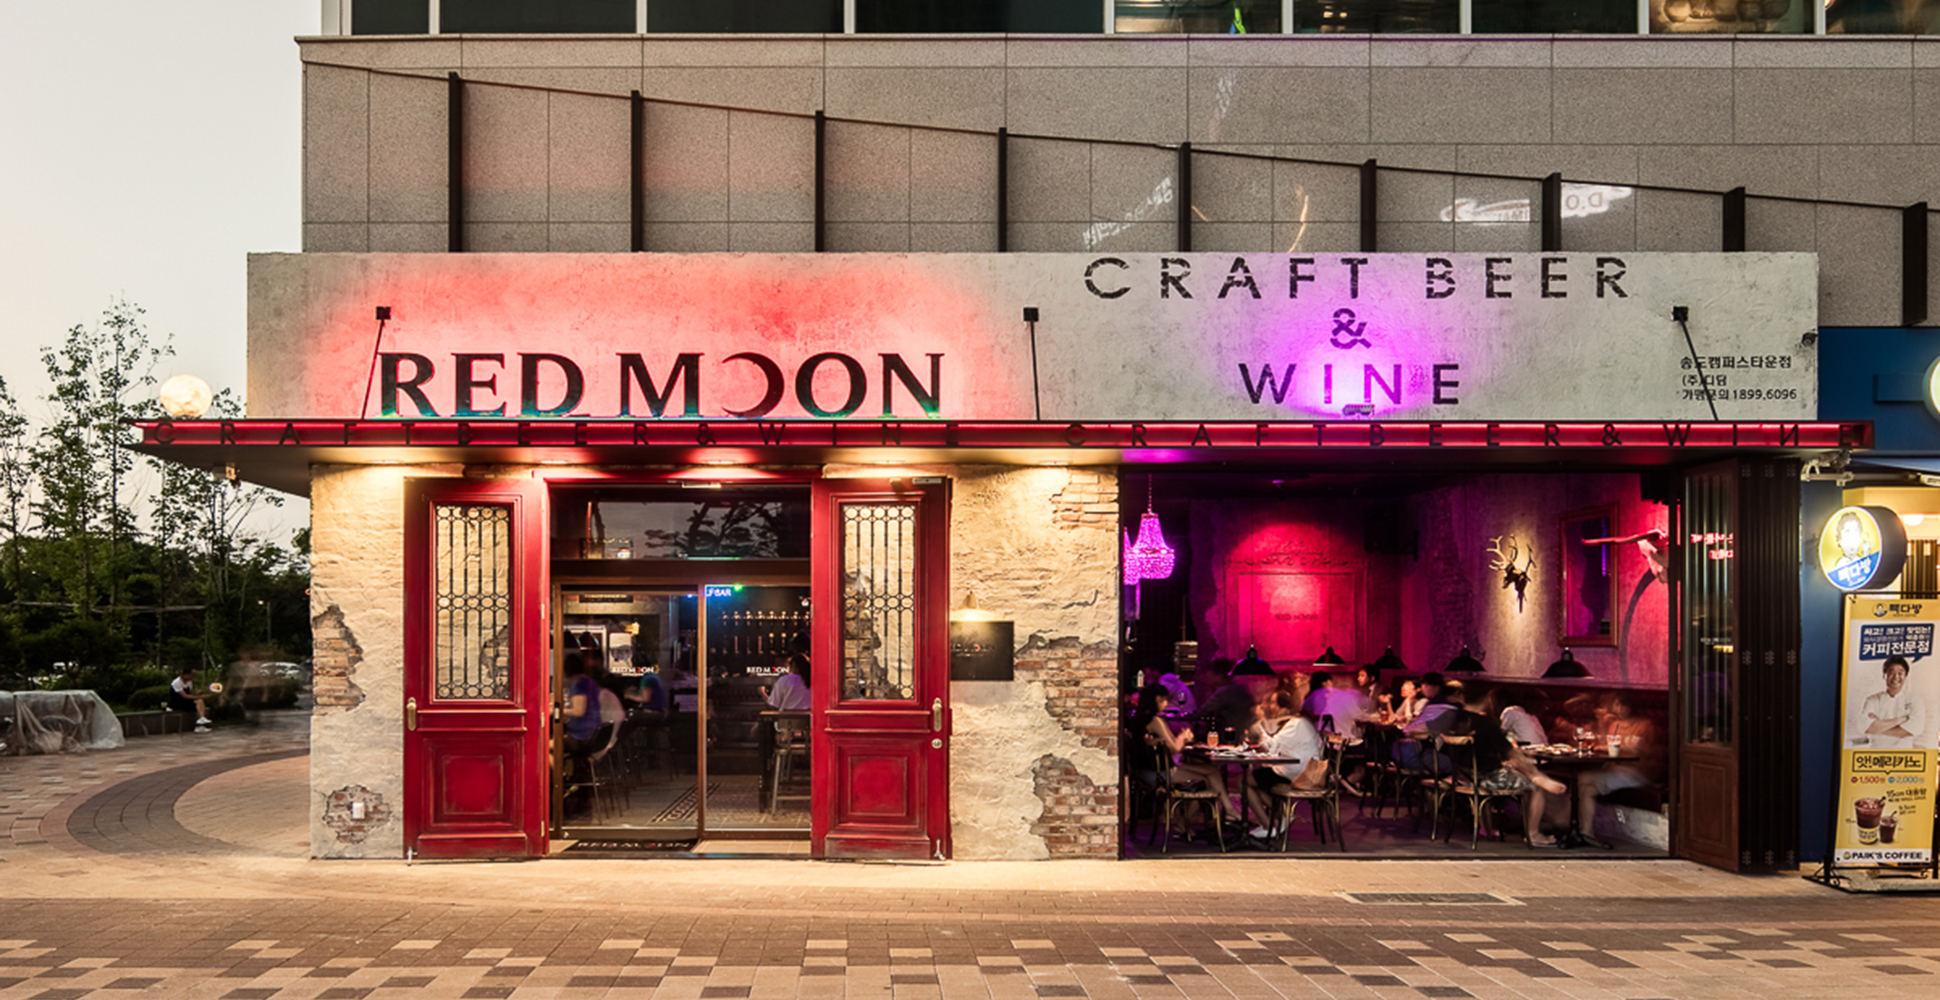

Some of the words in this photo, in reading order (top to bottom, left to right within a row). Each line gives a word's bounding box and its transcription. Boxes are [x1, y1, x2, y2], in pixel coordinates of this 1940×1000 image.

[1084, 257, 1368, 299] CRAFT
[1425, 257, 1628, 299] BEER
[1330, 308, 1372, 349] &
[376, 352, 588, 418] RED
[616, 352, 945, 418] MOON
[1239, 363, 1460, 404] WINE
[1733, 388, 1797, 401] 1899.6096
[746, 666, 763, 674] RED
[1852, 851, 1882, 860] PAIK'S
[1884, 851, 1923, 860] COFFEE
